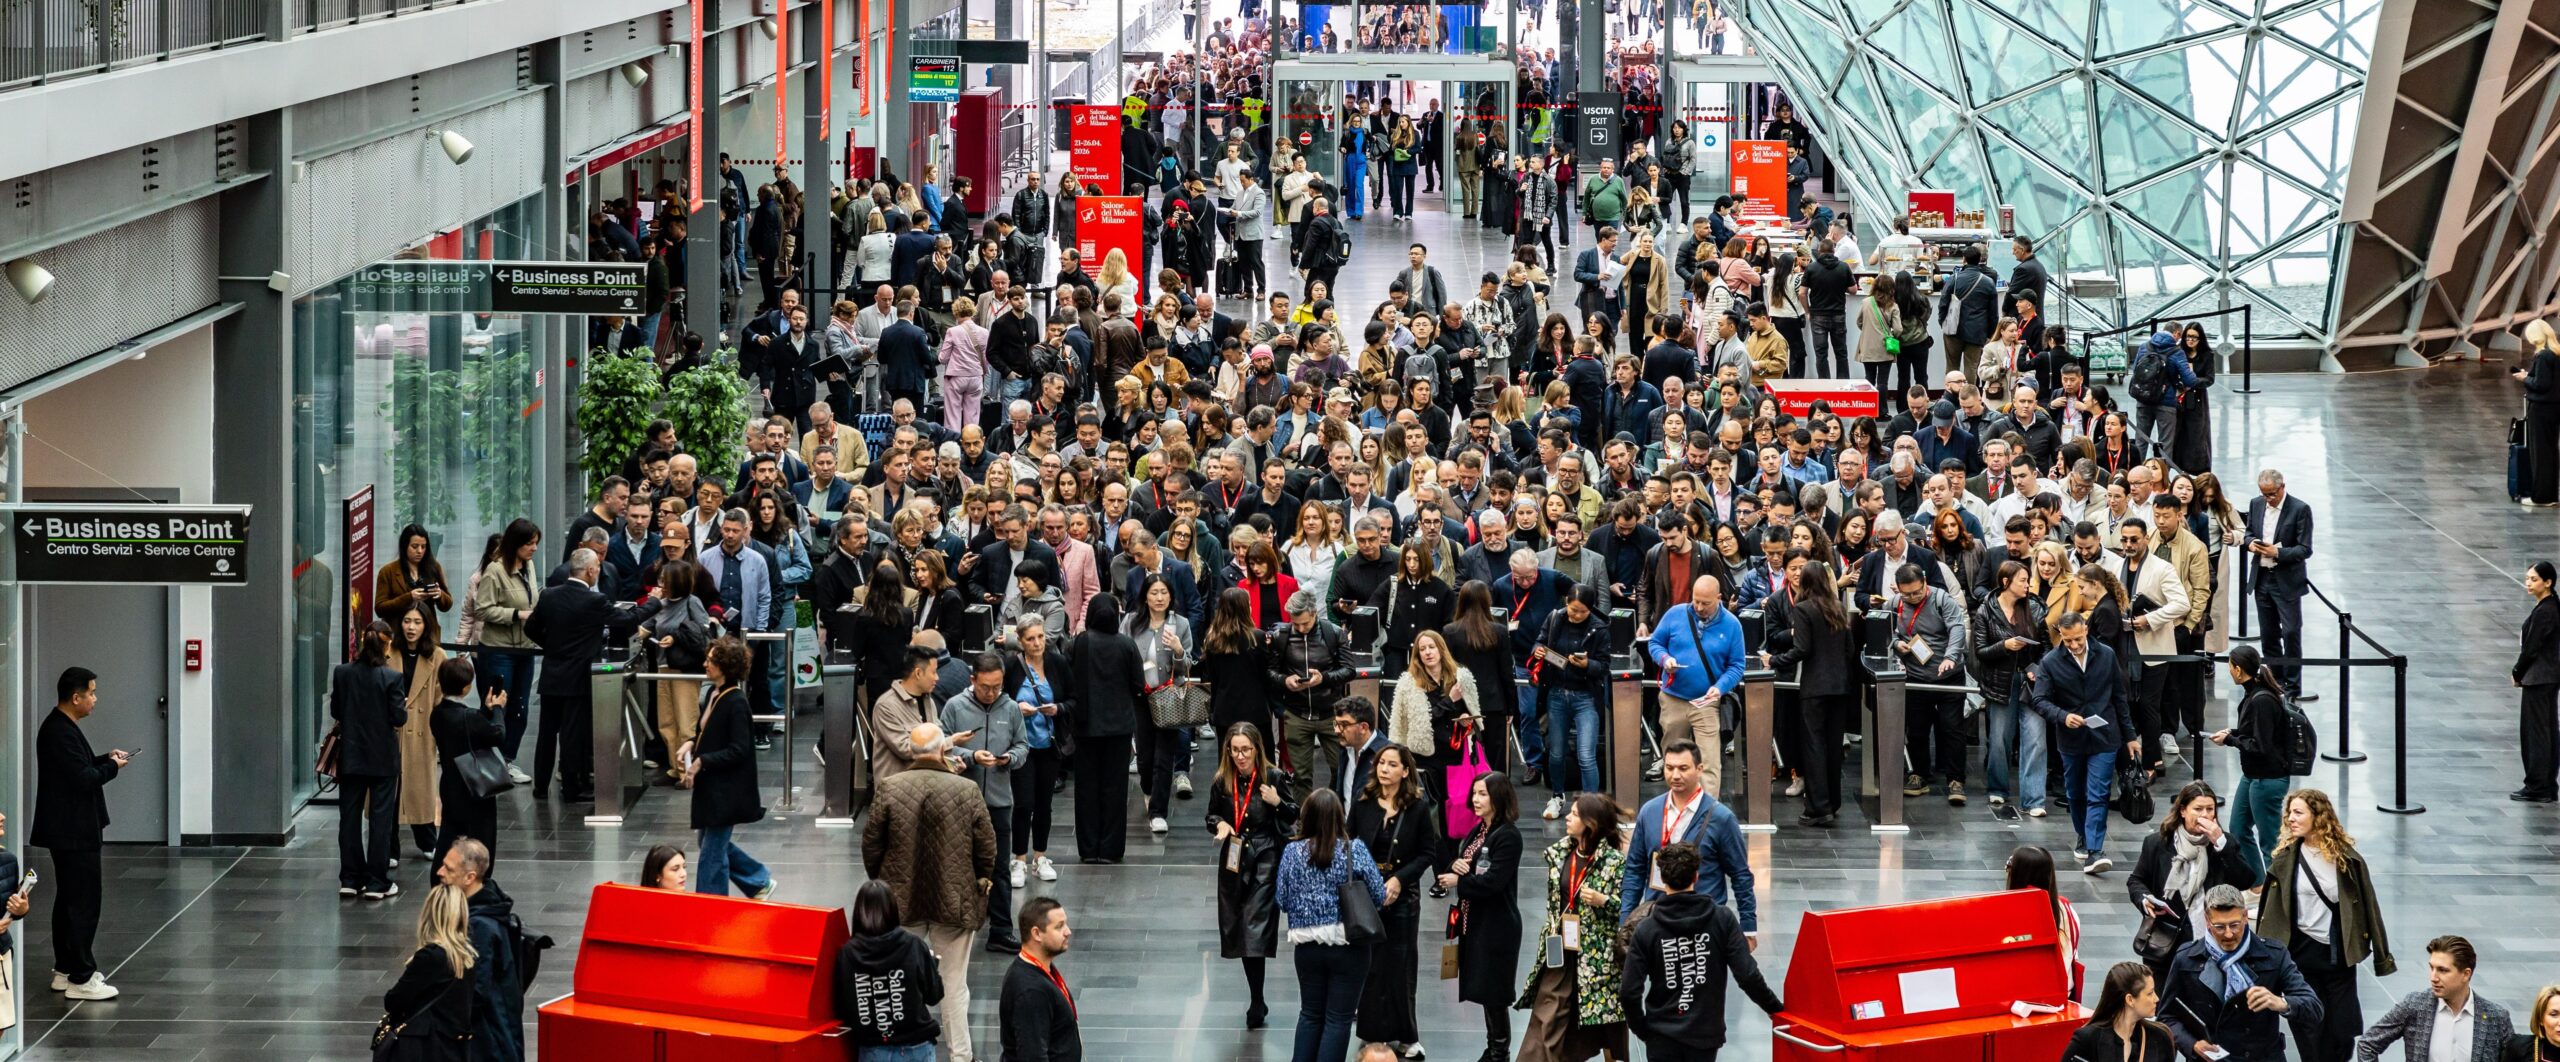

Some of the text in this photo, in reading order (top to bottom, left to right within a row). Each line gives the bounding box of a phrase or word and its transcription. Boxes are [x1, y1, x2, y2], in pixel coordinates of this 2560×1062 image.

[1583, 107, 1615, 115] USCITA
[1590, 117, 1607, 125] EXIT
[1101, 201, 1124, 209] Salone
[1101, 216, 1125, 224] Milano
[512, 270, 637, 285] Business Point
[511, 286, 540, 295] Centro
[542, 287, 569, 296] Servizi
[577, 287, 609, 296] Service
[611, 288, 638, 297] Centre
[46, 518, 233, 540] Business Point
[47, 543, 89, 556] Centro
[92, 544, 133, 556] Servizi
[144, 544, 190, 556] Service
[193, 545, 236, 557] Centre
[1677, 936, 1695, 960] del
[1661, 938, 1679, 989] Milano
[1694, 932, 1711, 985] Salone
[854, 973, 873, 1026] Milano
[888, 969, 906, 1021] Salone
